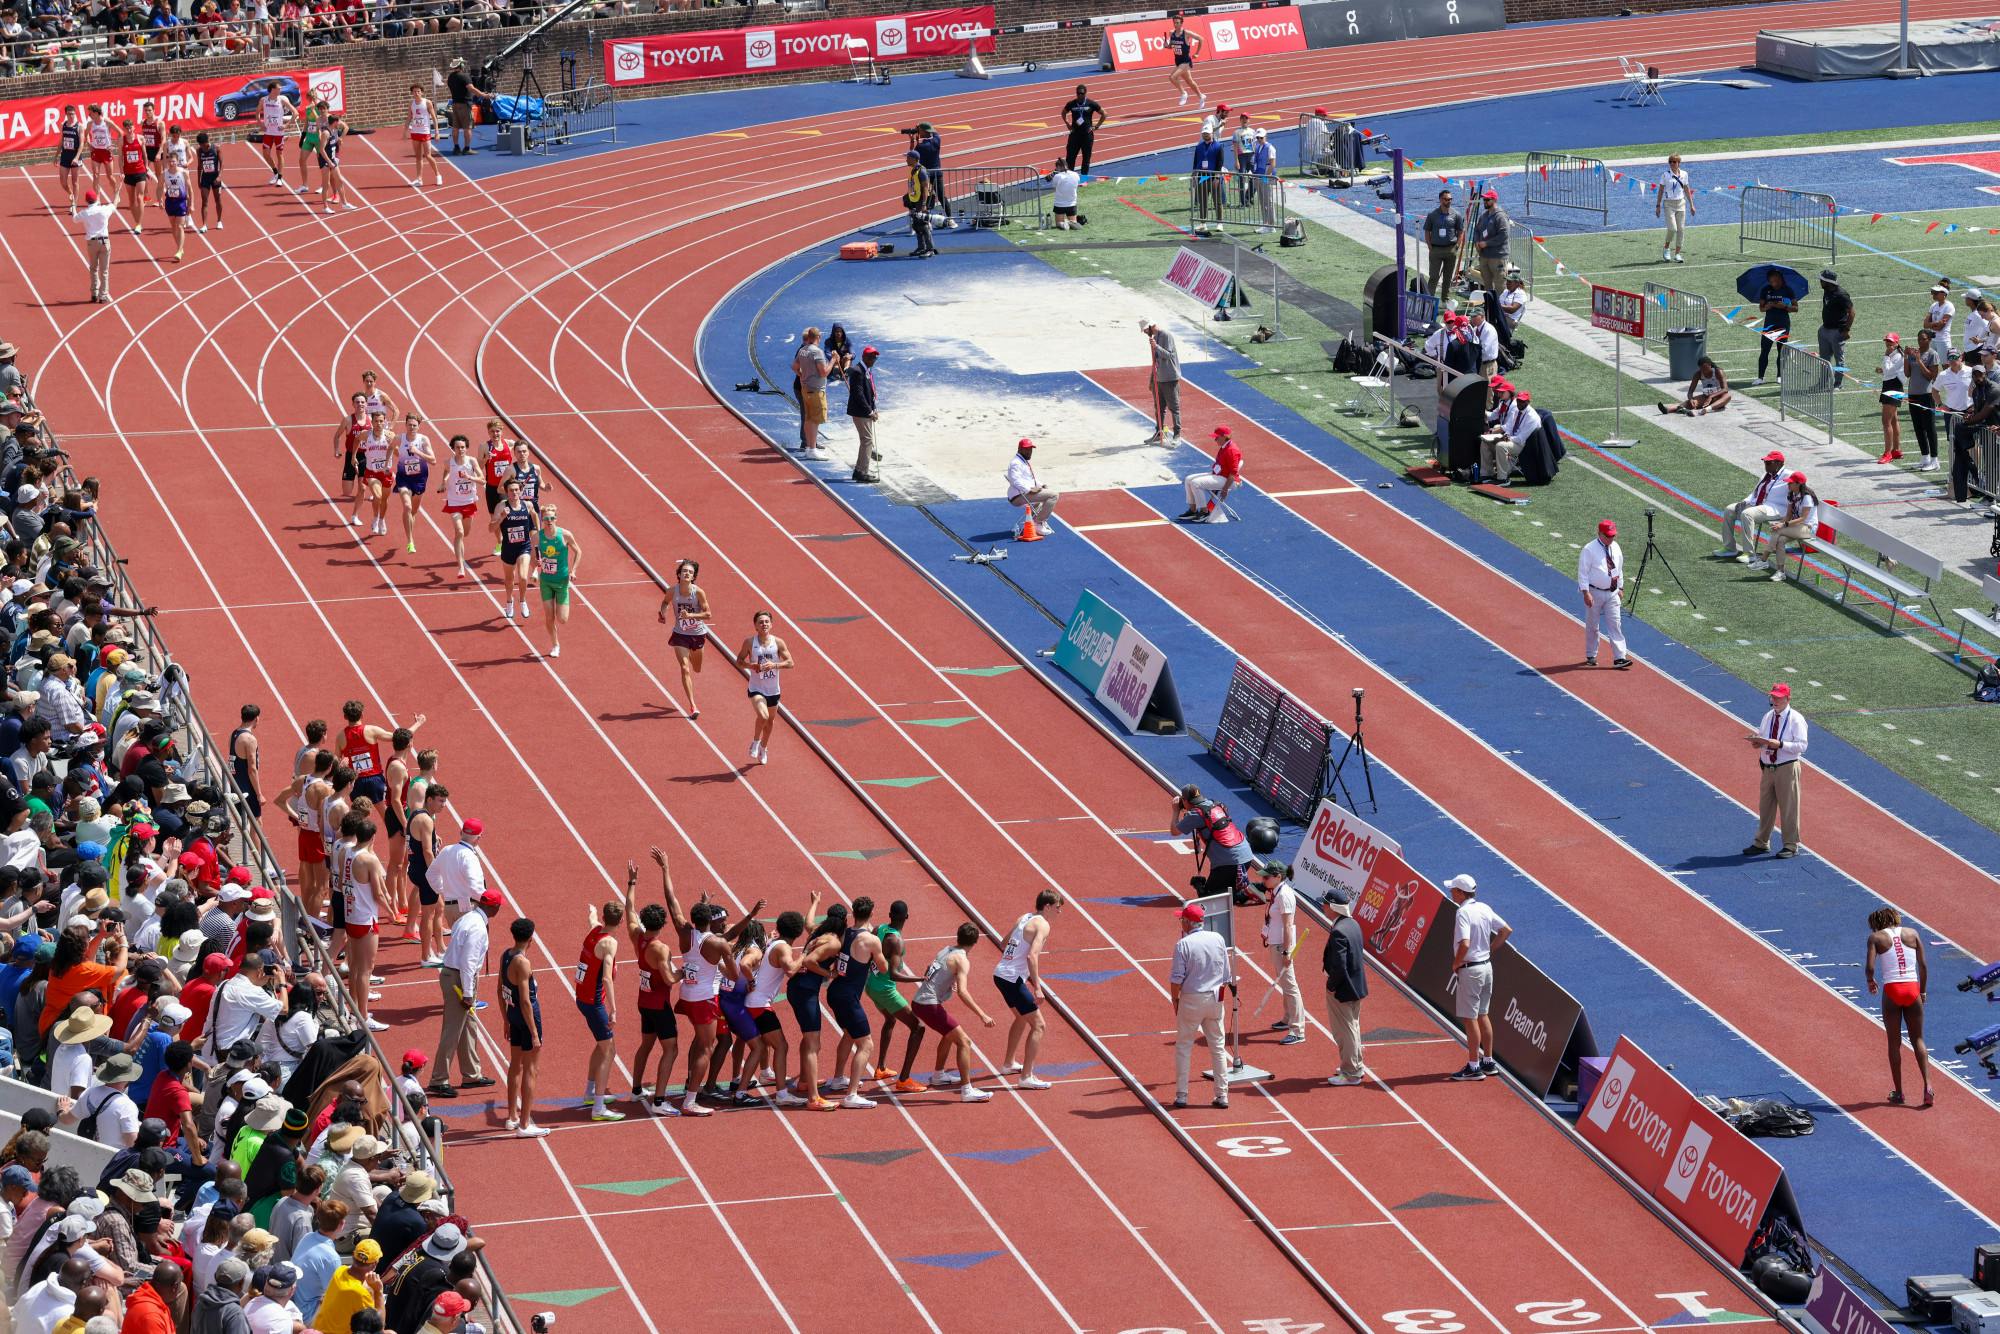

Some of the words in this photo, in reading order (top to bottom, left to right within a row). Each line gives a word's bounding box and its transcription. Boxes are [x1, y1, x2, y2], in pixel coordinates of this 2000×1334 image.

[912, 21, 984, 43] TOYOTA
[1241, 20, 1299, 40] TOYOTA
[650, 46, 724, 67] TOYOTA
[782, 33, 853, 55] TOYOTA
[133, 92, 205, 125] TURN
[1166, 250, 1201, 290] JAMAICA
[1191, 265, 1228, 305] JAMAICA
[1599, 316, 1633, 334] PERFORMANCE
[682, 618, 695, 627] AD
[1068, 610, 1101, 660] College
[763, 671, 775, 680] AA
[1106, 661, 1148, 721] JAMBAR
[1310, 807, 1379, 873] Rekorta
[1301, 857, 1309, 872] The
[1310, 862, 1328, 882] World's
[1365, 889, 1385, 909] GOOD
[1358, 902, 1379, 924] MOVE
[1893, 936, 1907, 976] CORNELL
[1504, 997, 1536, 1039] Dream
[1531, 1020, 1548, 1052] On.
[1622, 1093, 1673, 1159] TOYOTA
[1216, 1136, 1292, 1158] 3
[1701, 1162, 1758, 1230] TOYOTA
[1515, 1299, 1602, 1326] 2
[1654, 1291, 1727, 1318] 1
[1382, 1309, 1466, 1334] 3
